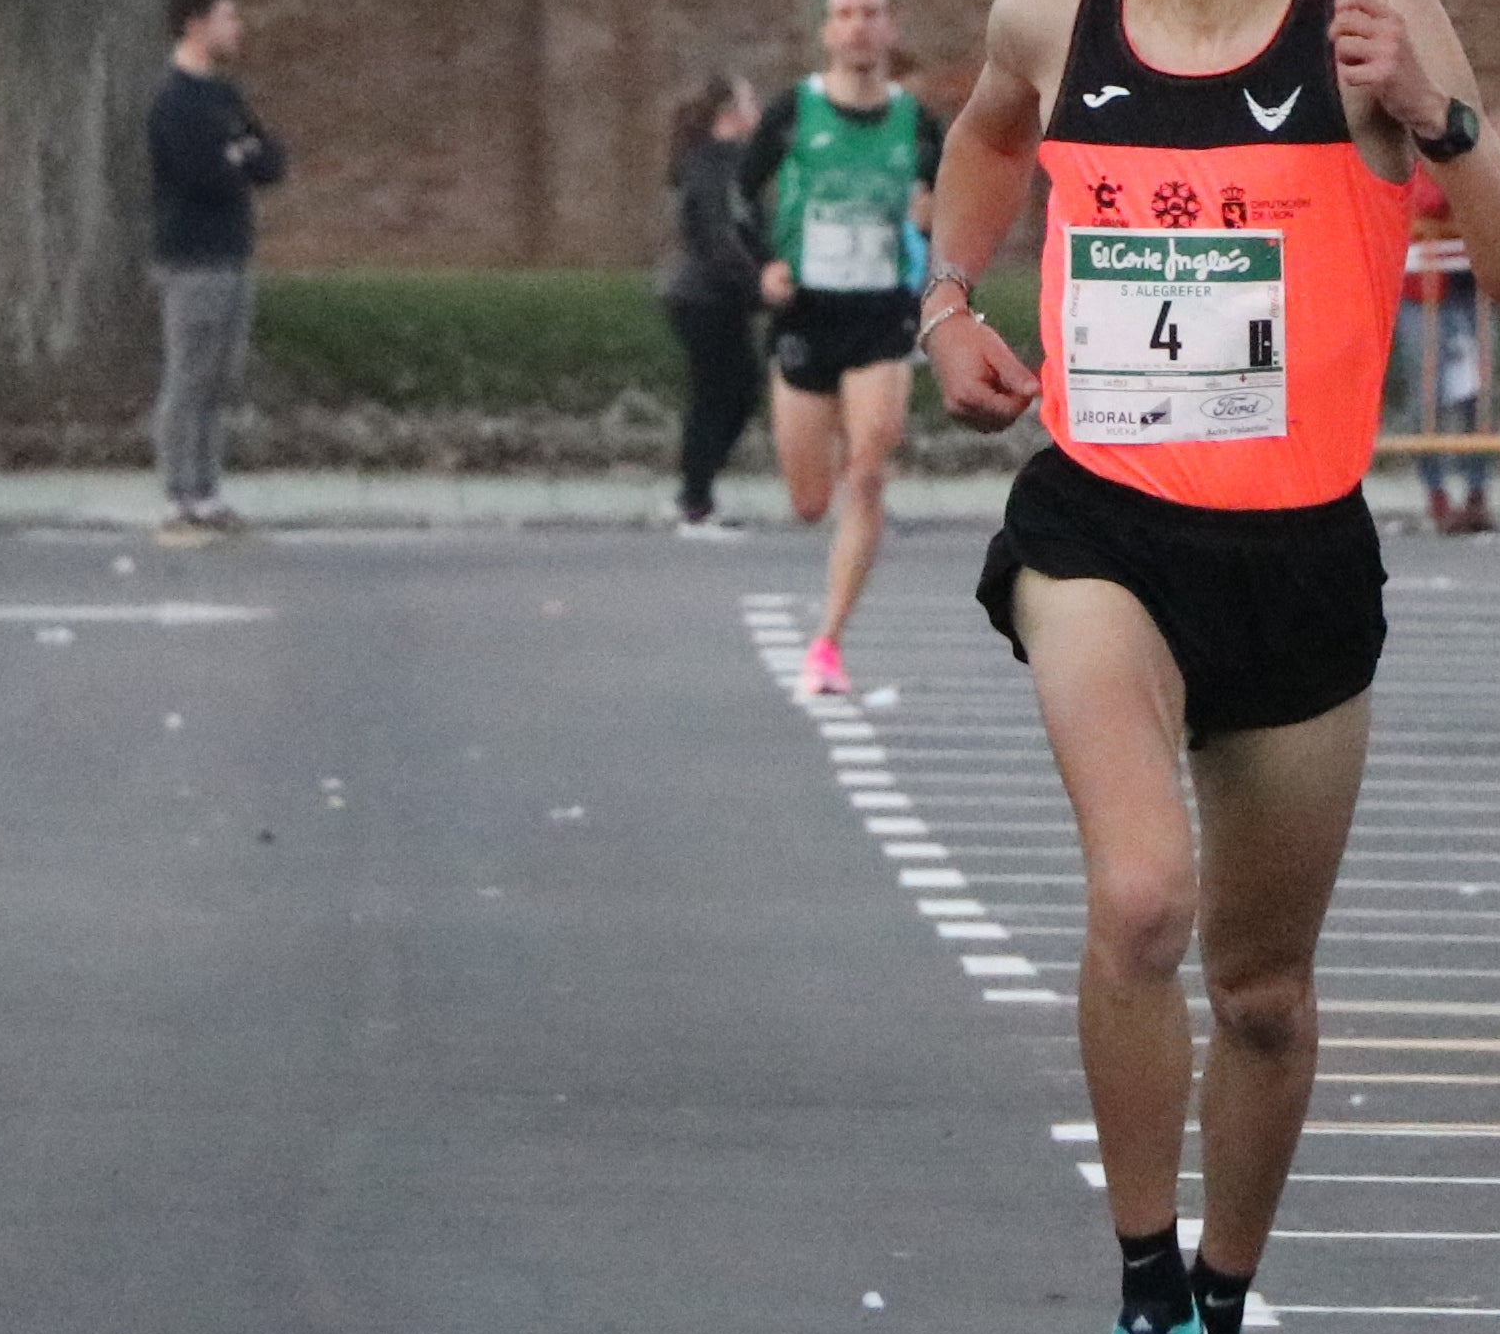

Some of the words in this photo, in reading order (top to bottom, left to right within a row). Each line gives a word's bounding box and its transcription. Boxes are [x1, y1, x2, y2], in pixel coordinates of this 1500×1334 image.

[1090, 240, 1111, 269] El
[1111, 242, 1162, 271] Corte
[1163, 237, 1250, 282] Inglés
[1149, 300, 1182, 361] 4
[1075, 409, 1137, 426] LABORAL
[1212, 395, 1260, 417] Ford
